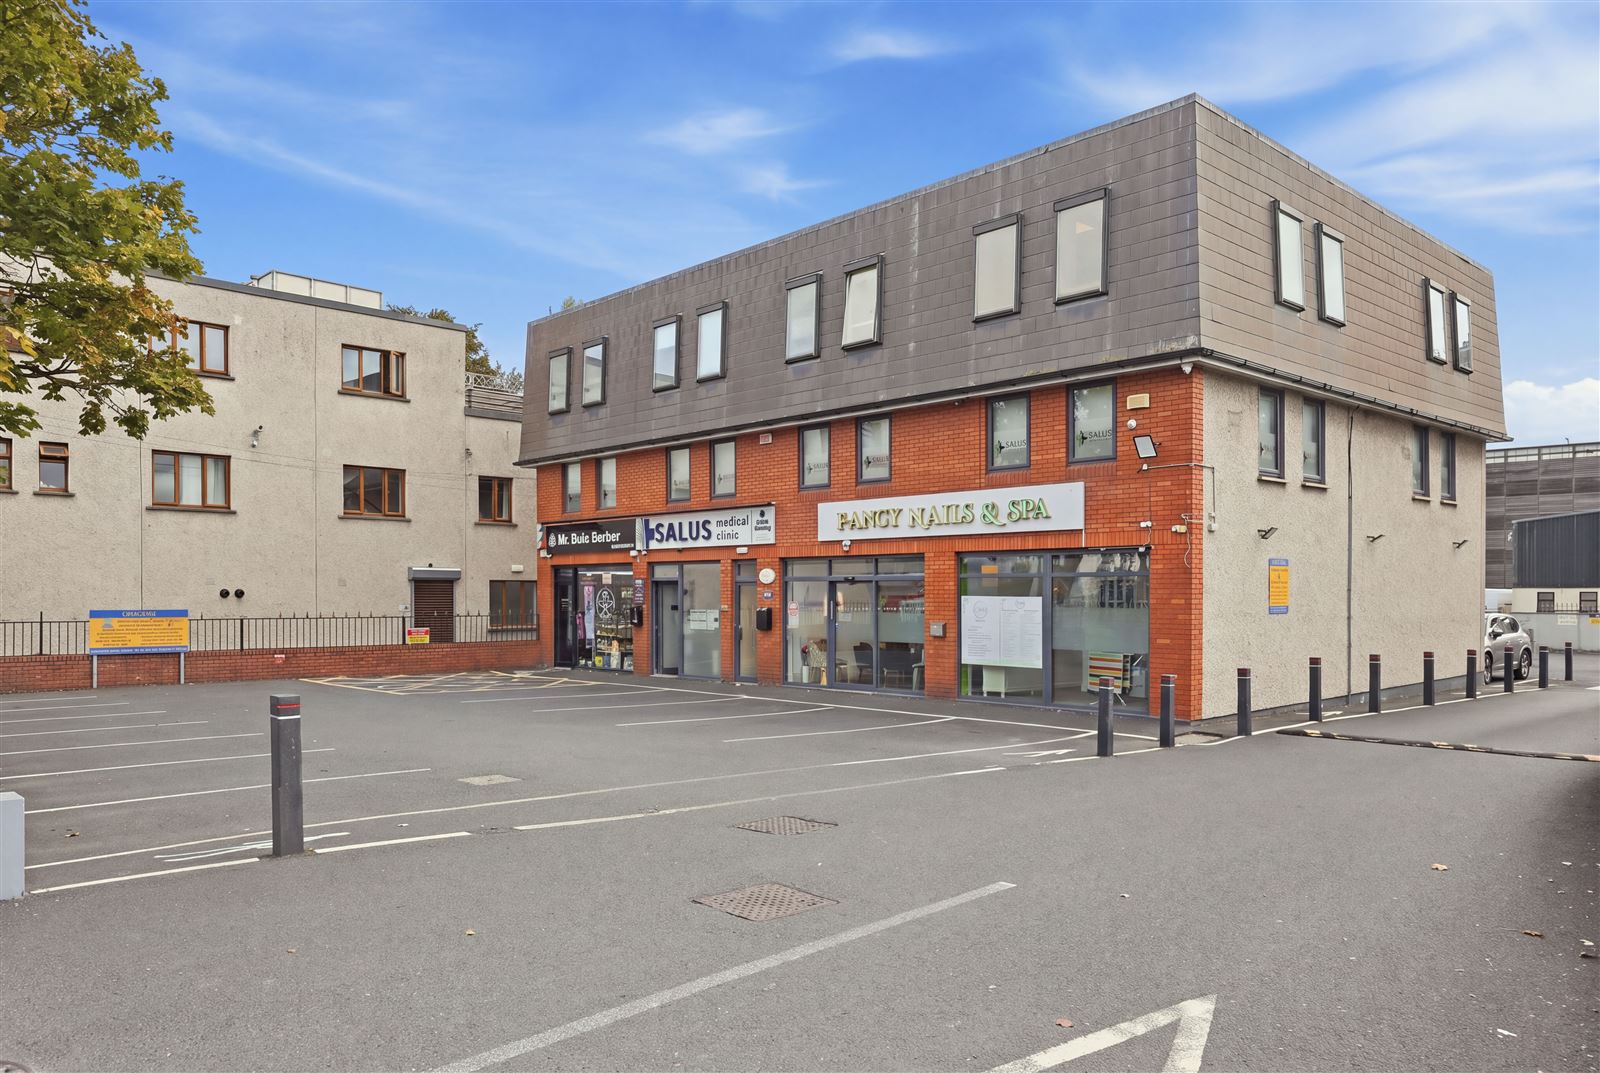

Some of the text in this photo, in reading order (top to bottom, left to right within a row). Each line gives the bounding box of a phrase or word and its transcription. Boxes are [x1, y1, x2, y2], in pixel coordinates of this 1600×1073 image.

[1088, 429, 1112, 439] SALUS
[1005, 440, 1027, 449] SALUS
[716, 514, 749, 527] medical
[837, 497, 1051, 531] FANCY NAILS & SPA
[655, 519, 712, 543] SALUS
[716, 530, 739, 541] clinic
[558, 533, 570, 546] Mr.
